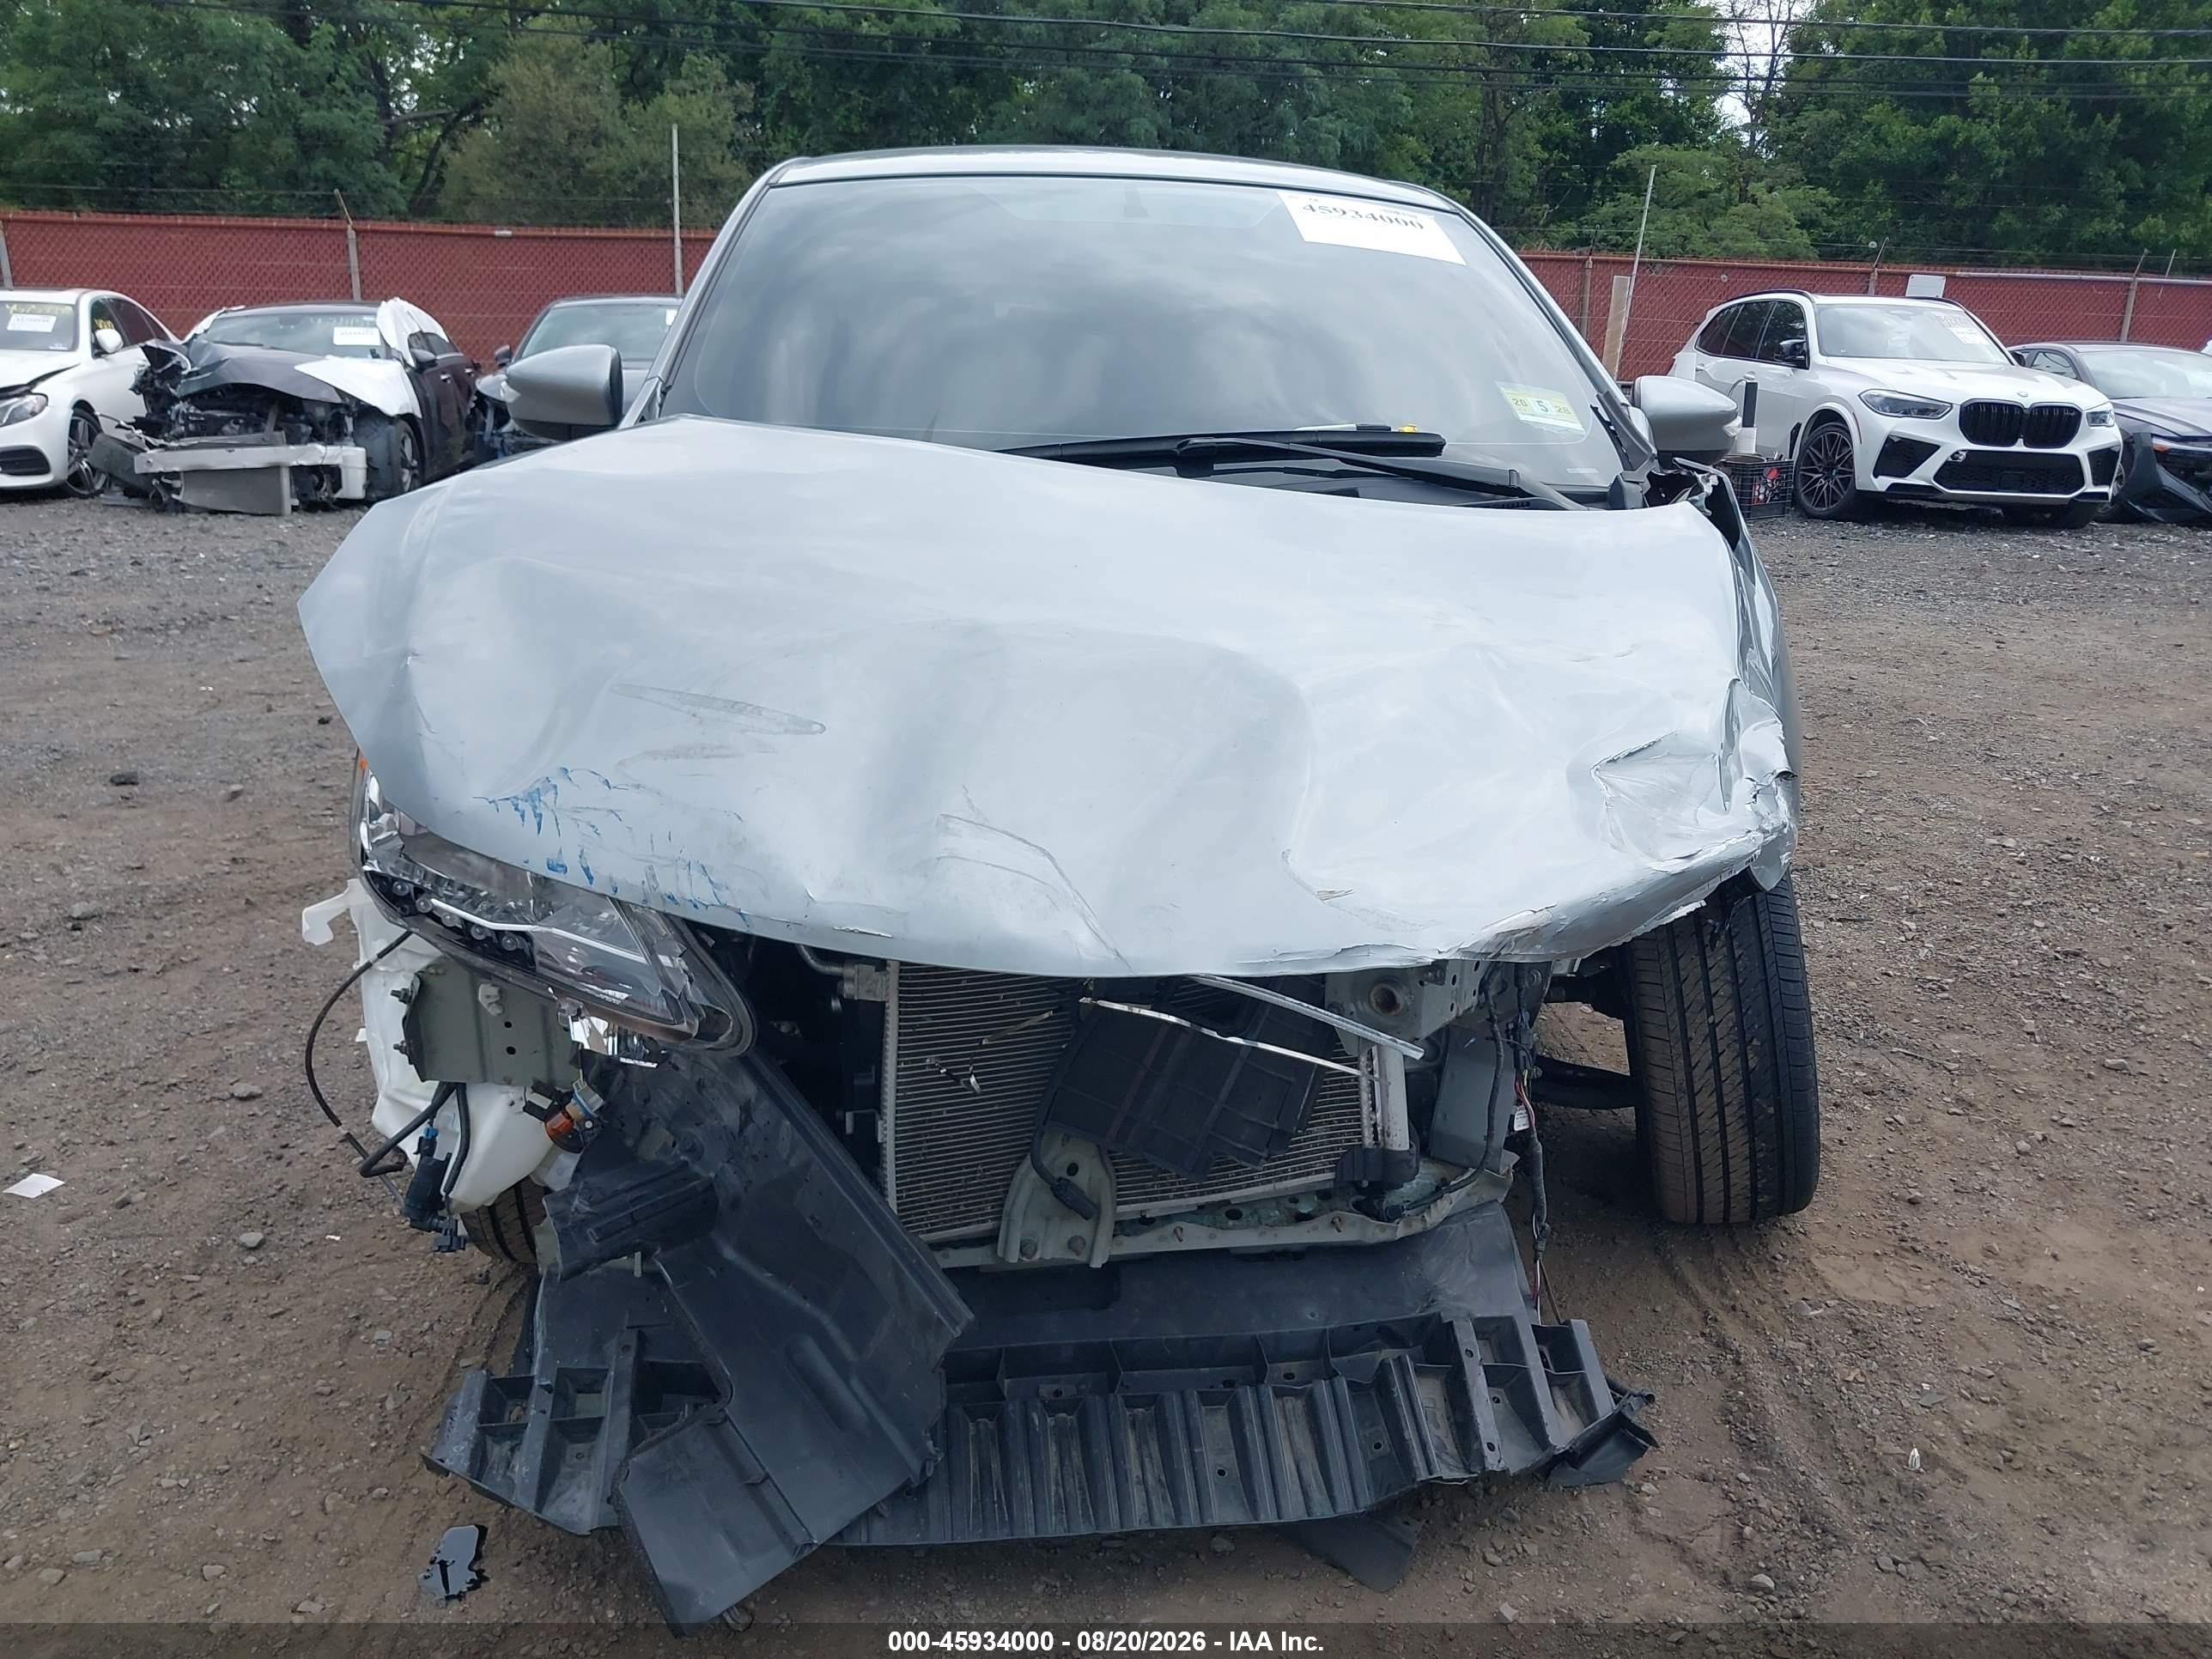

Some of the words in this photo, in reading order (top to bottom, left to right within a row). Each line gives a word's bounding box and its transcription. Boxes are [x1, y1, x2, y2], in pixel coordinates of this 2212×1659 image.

[1302, 204, 1425, 229] 45934000
[1511, 398, 1528, 407] 20
[1535, 399, 1549, 413] 5
